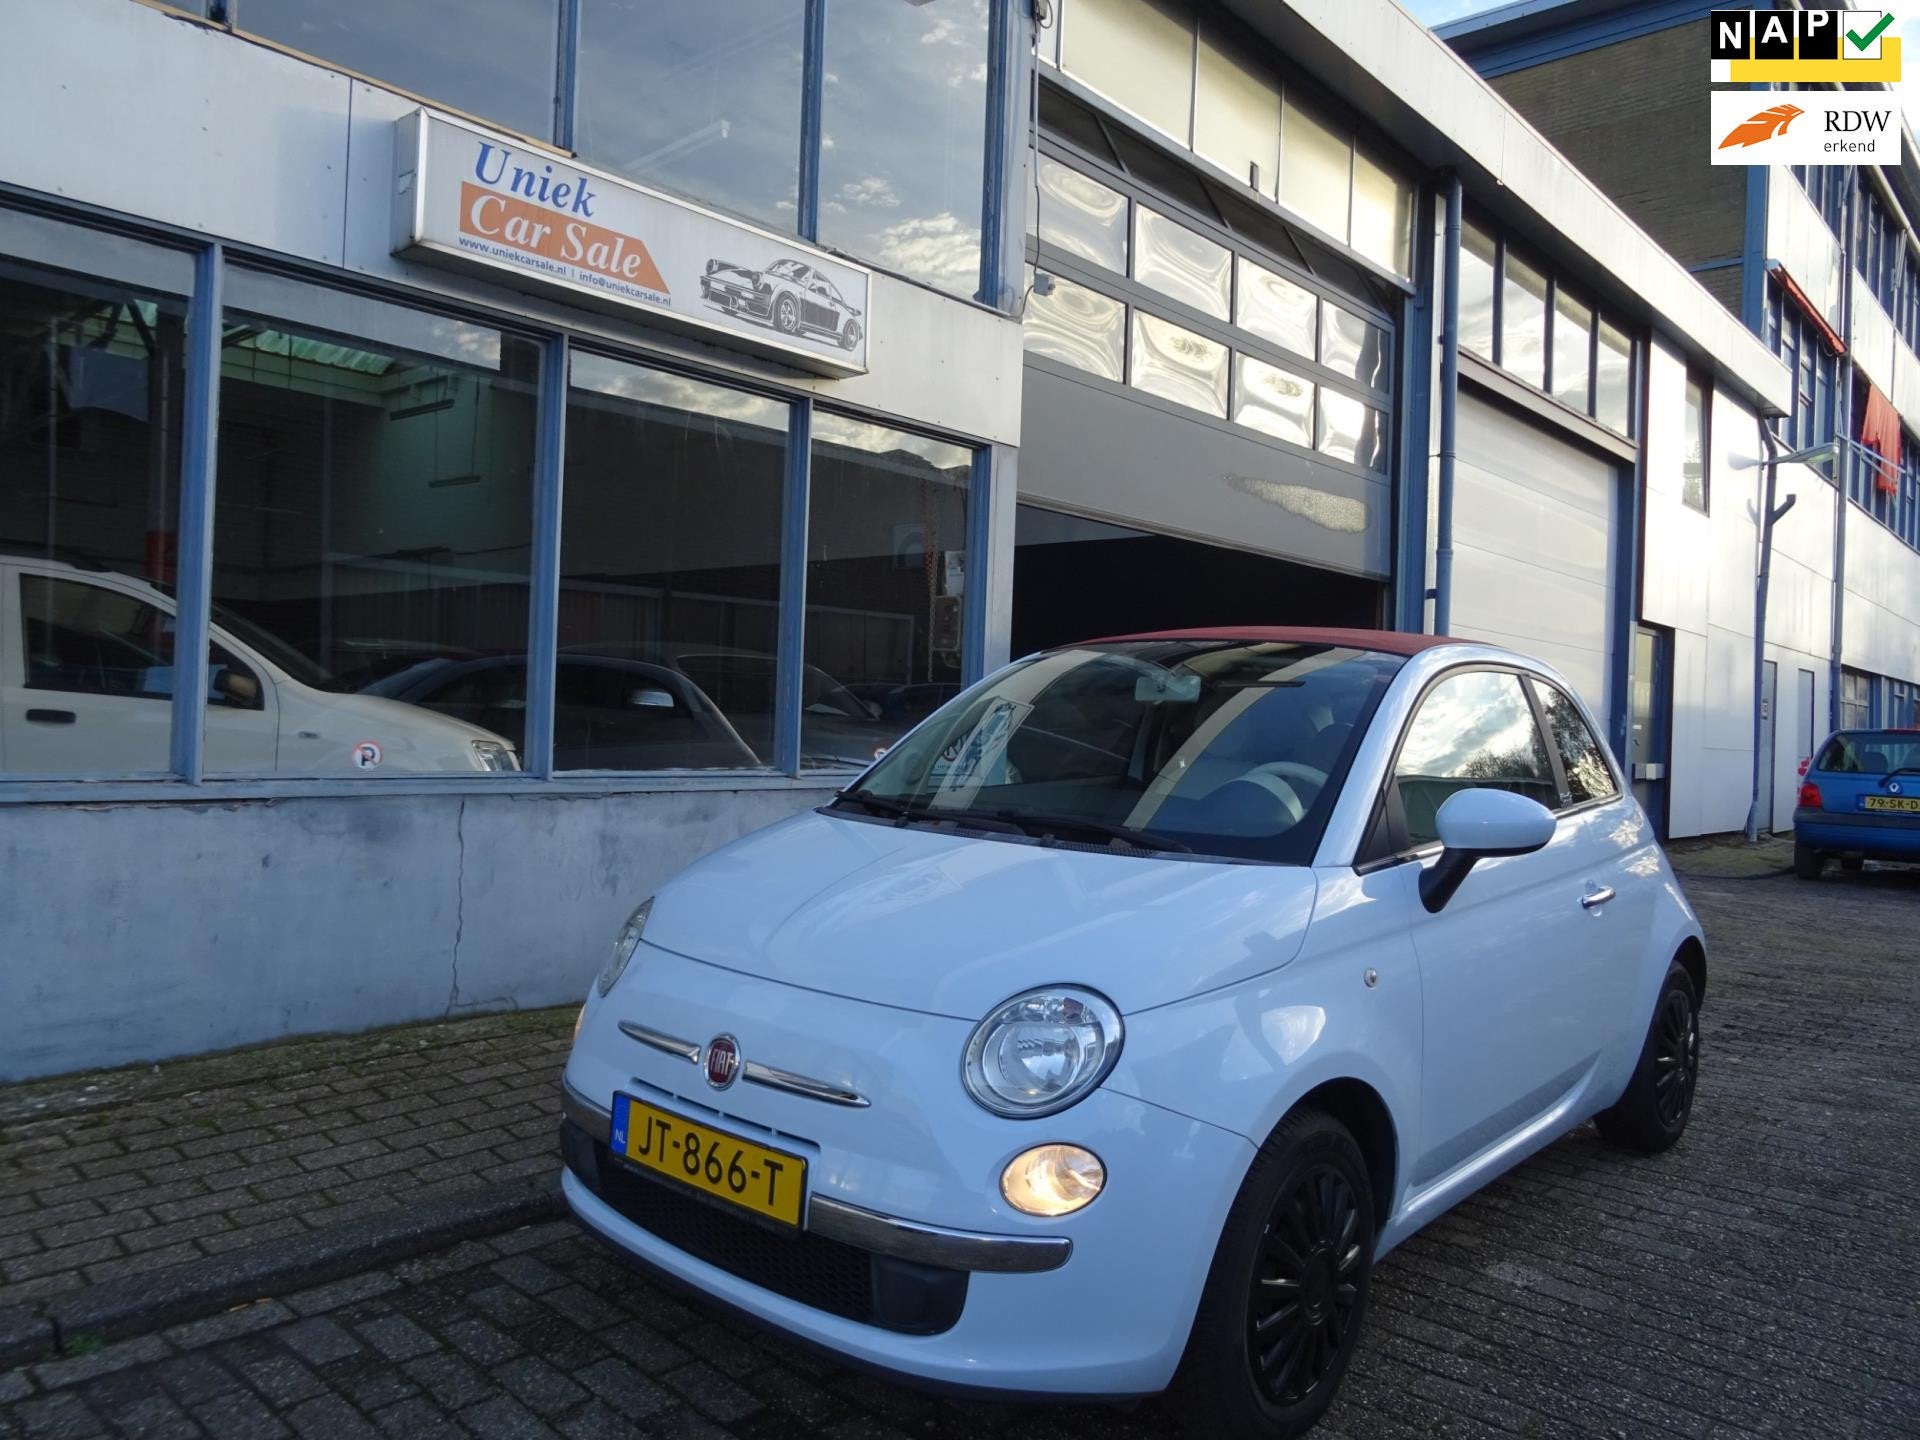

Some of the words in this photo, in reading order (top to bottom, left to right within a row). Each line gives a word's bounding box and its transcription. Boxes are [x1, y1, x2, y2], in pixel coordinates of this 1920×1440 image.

[474, 141, 597, 218] Uniek
[458, 236, 567, 276] www.uniekcarsale.nl
[579, 270, 671, 307] info@uniekcarsale.nl
[471, 194, 552, 249] Car
[560, 223, 641, 278] Sale
[711, 1048, 734, 1076] FIAT
[614, 1128, 626, 1145] NL
[637, 1115, 785, 1207] JT-866-T
